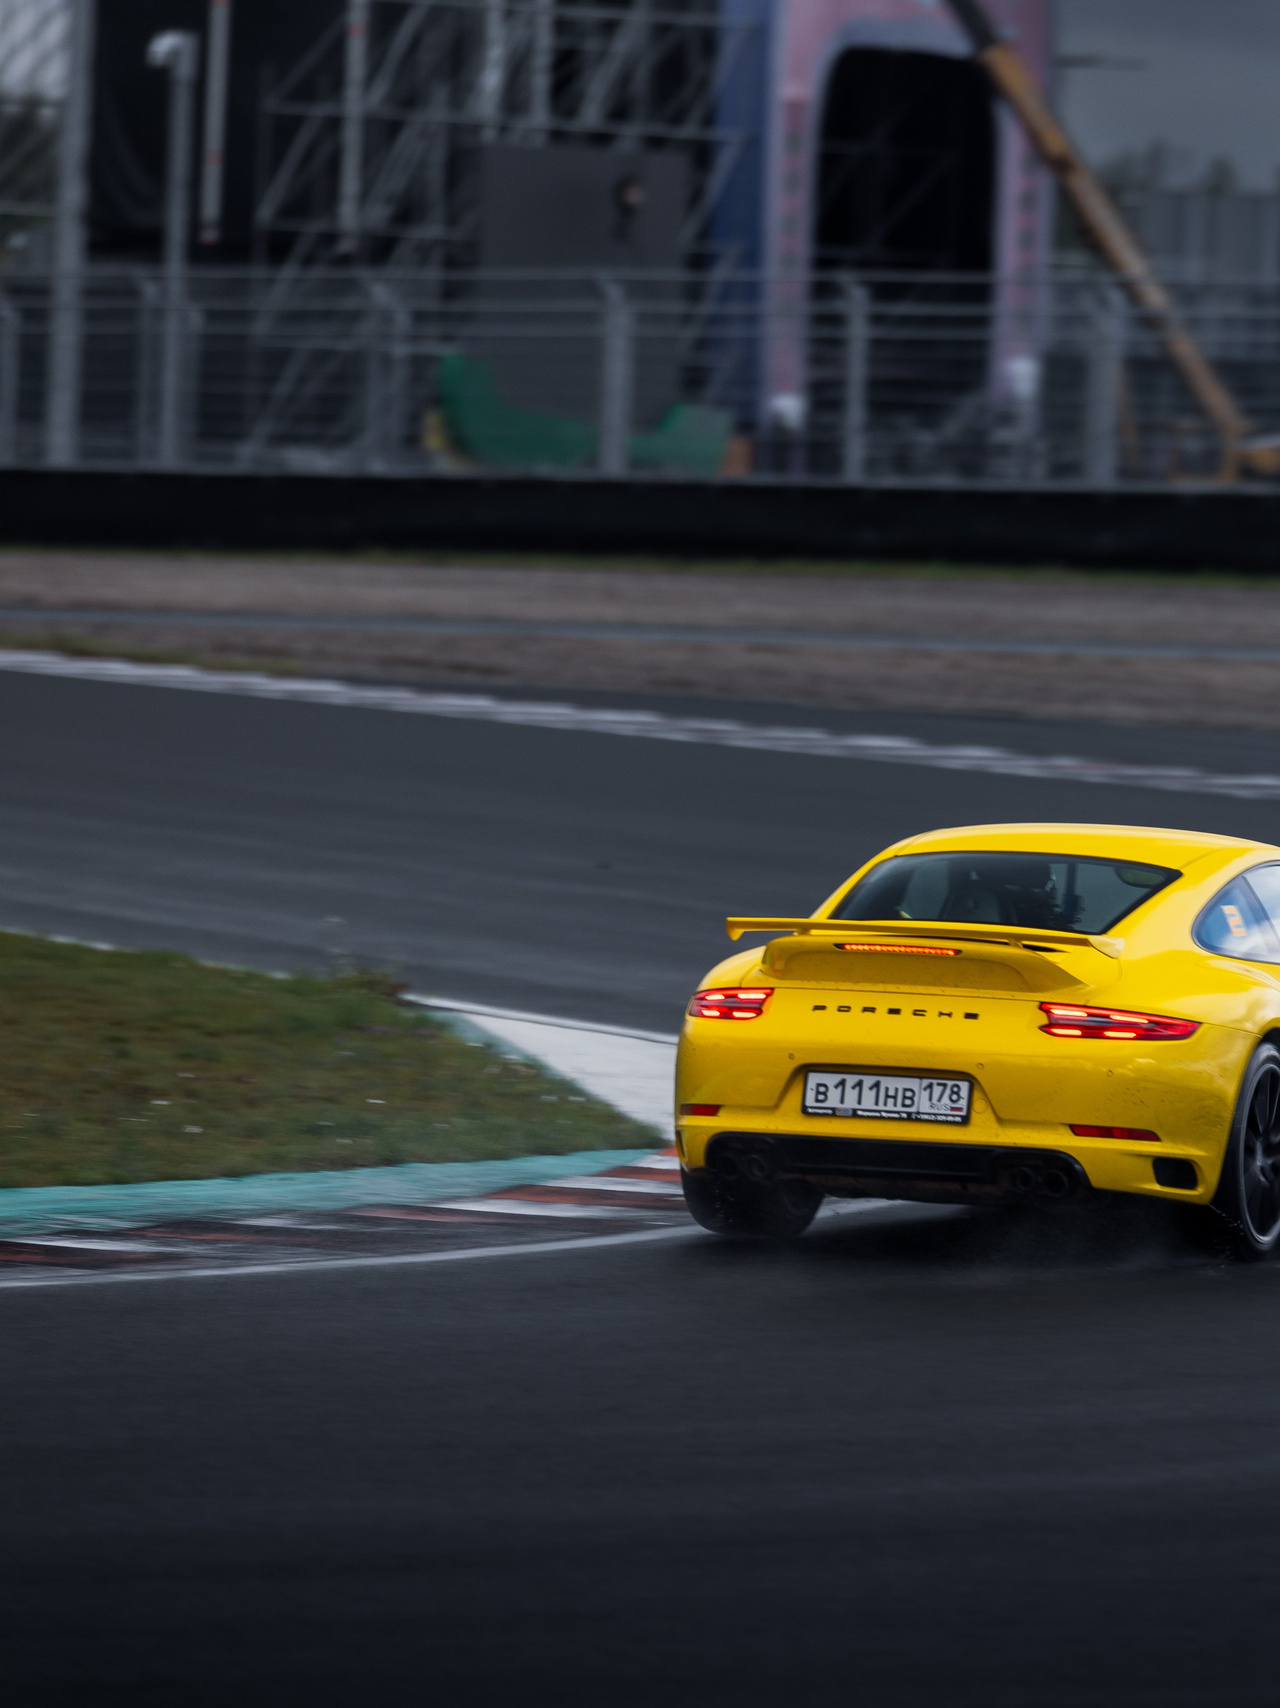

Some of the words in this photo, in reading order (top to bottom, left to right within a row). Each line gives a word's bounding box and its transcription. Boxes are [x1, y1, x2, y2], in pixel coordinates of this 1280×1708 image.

[812, 1005, 980, 1020] PORSCHE
[922, 1081, 962, 1104] 178
[929, 1102, 950, 1112] RUS
